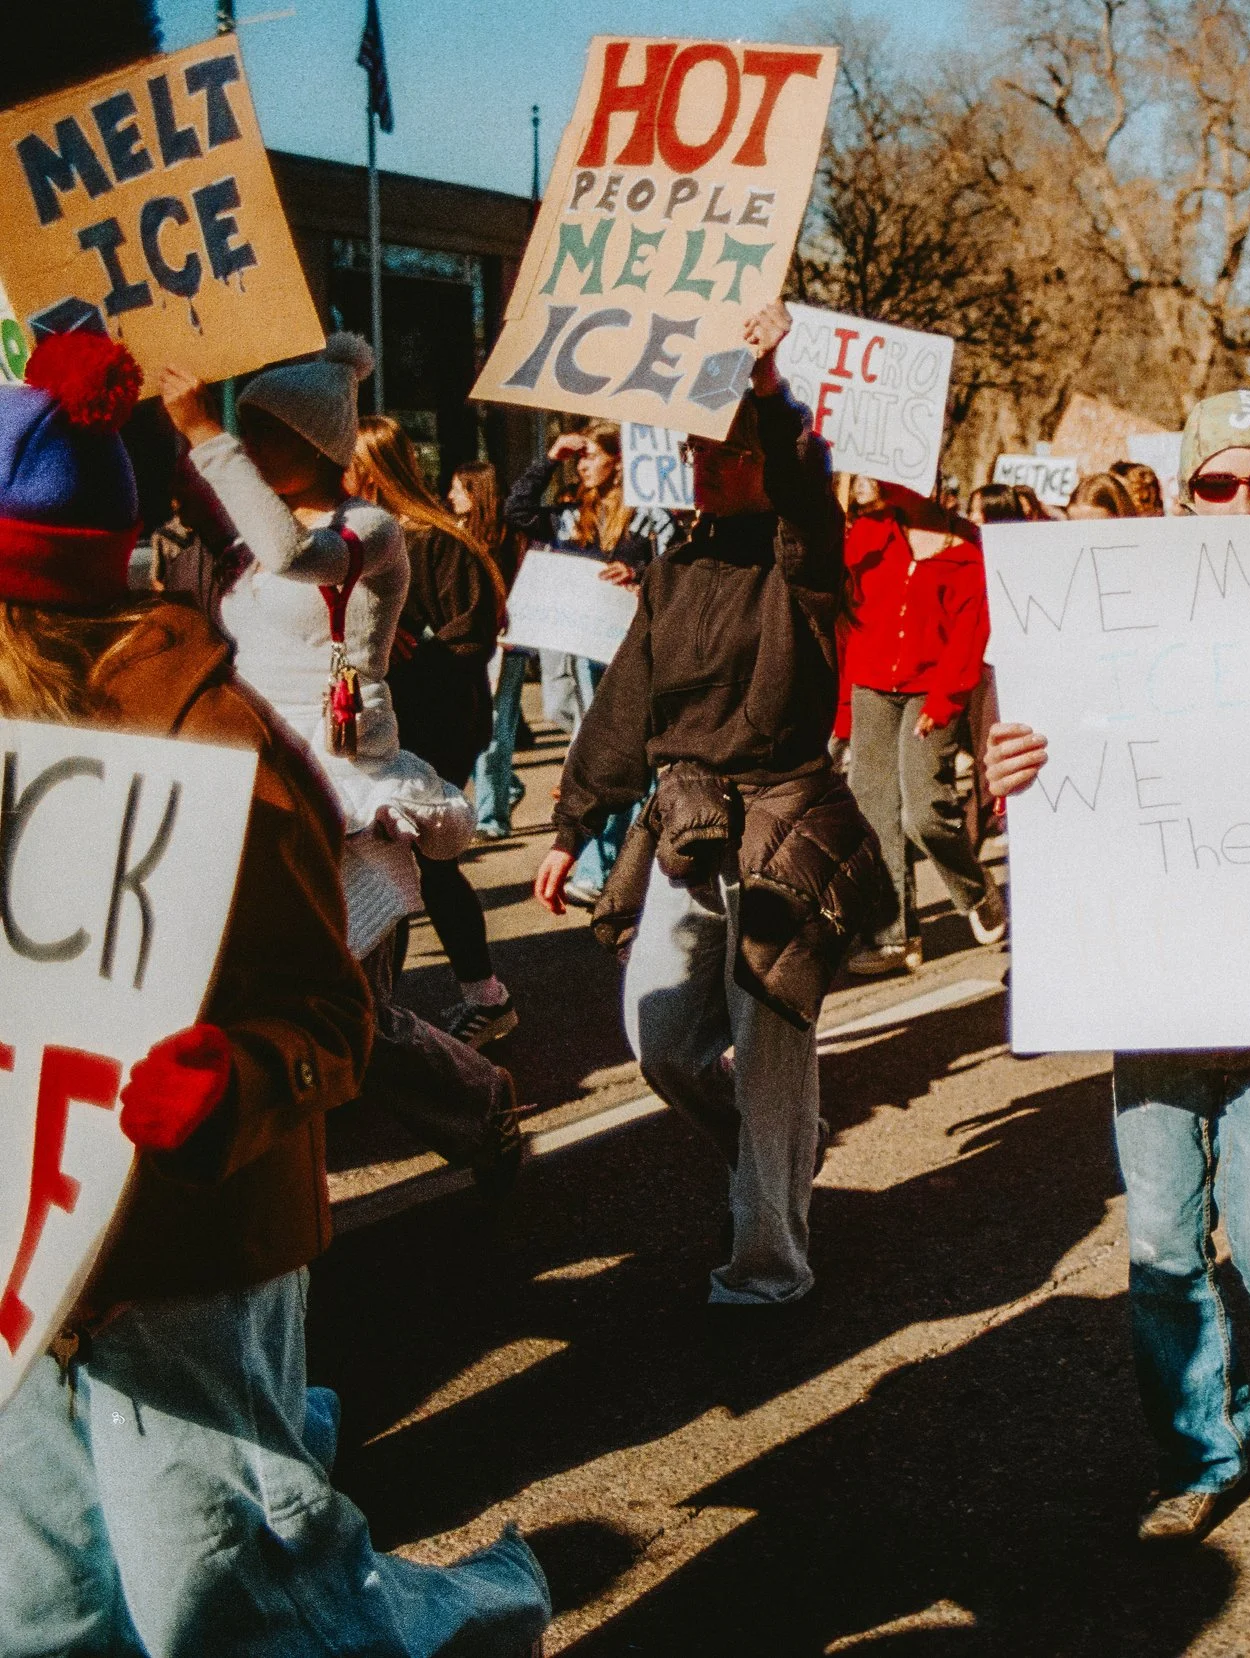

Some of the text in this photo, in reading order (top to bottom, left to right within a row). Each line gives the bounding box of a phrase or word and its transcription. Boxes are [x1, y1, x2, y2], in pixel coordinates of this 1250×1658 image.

[15, 54, 241, 228] MELT
[576, 41, 824, 175] HOT
[568, 170, 777, 228] PEOPLE
[76, 175, 259, 318] ICE
[539, 217, 777, 305] MELT
[500, 304, 702, 404] ICE
[789, 320, 943, 397] MICRO
[996, 543, 1160, 635] WE
[1096, 640, 1250, 723] ICE
[1036, 739, 1182, 813] WE
